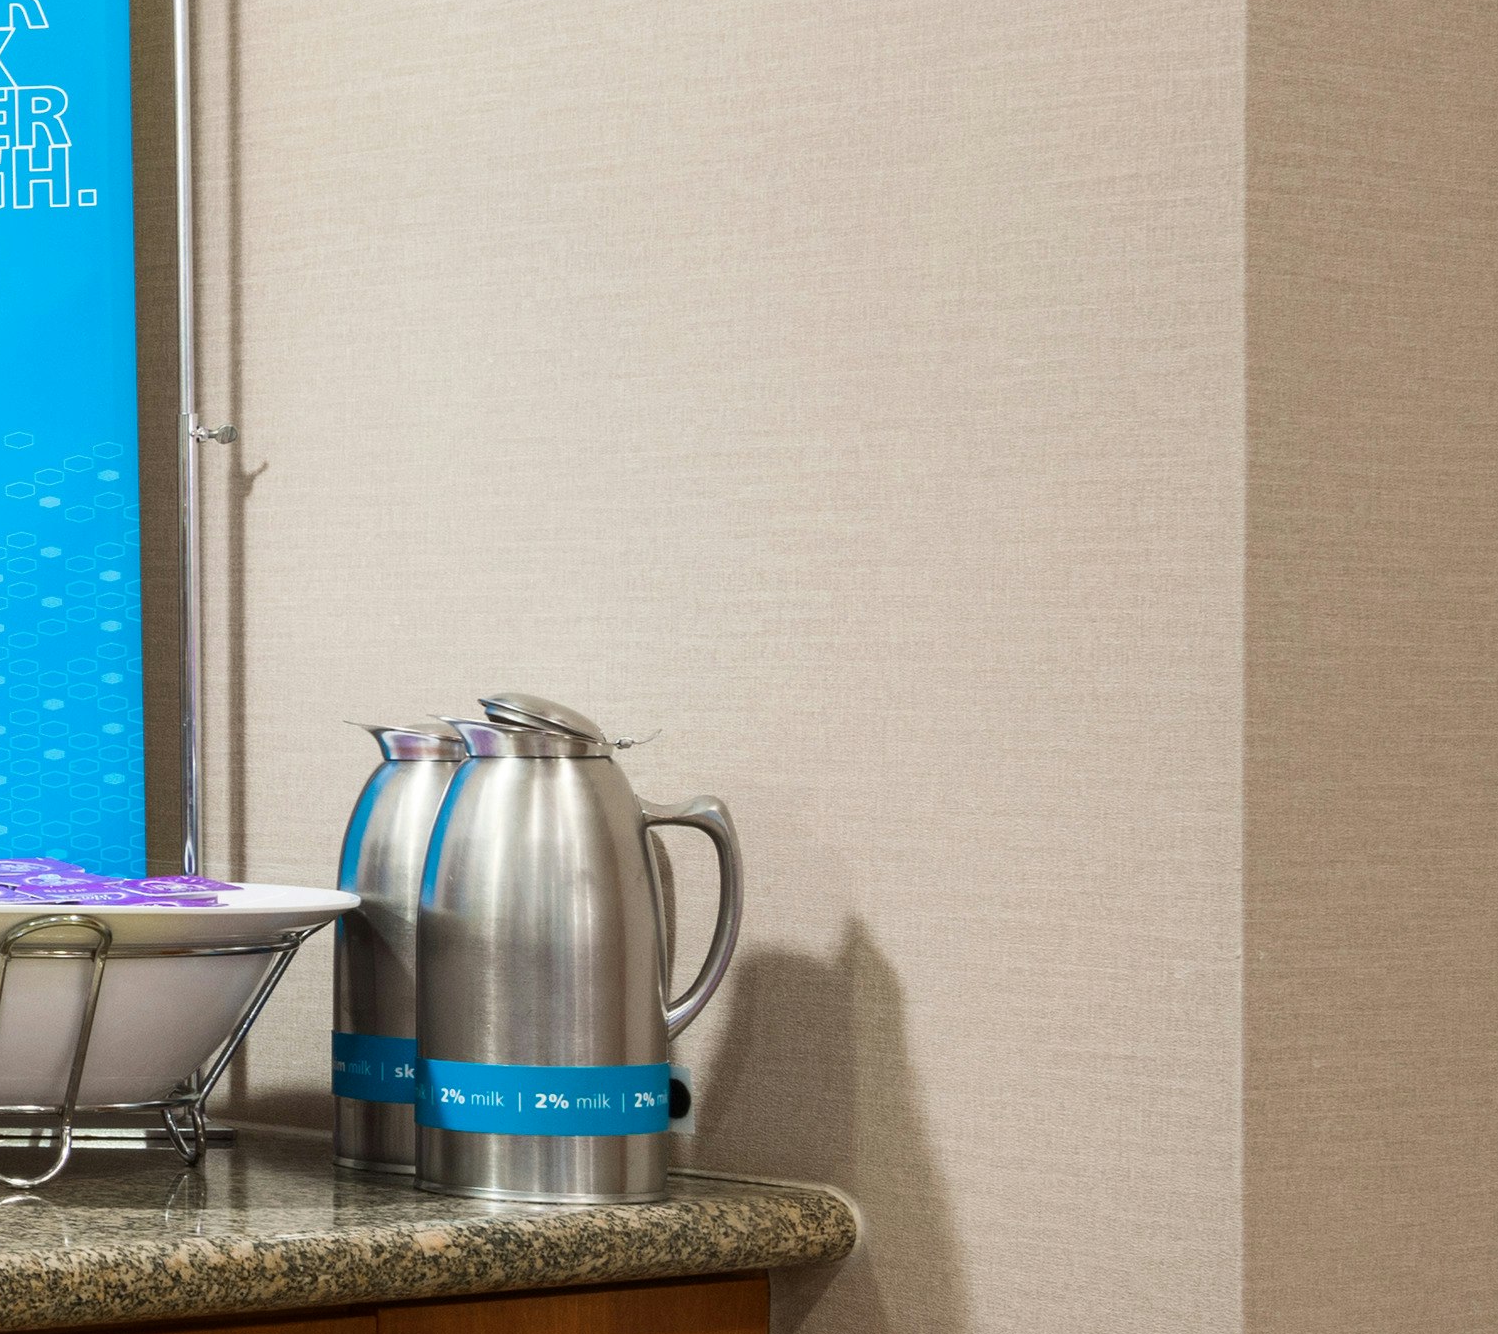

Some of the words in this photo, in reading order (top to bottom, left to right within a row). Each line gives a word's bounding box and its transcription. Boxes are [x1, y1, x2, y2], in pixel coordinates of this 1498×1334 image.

[440, 1087, 465, 1105] 2%
[470, 1091, 505, 1107] milk
[535, 1092, 570, 1109] 2%
[576, 1092, 611, 1109] milk
[634, 1091, 655, 1108] 2%
